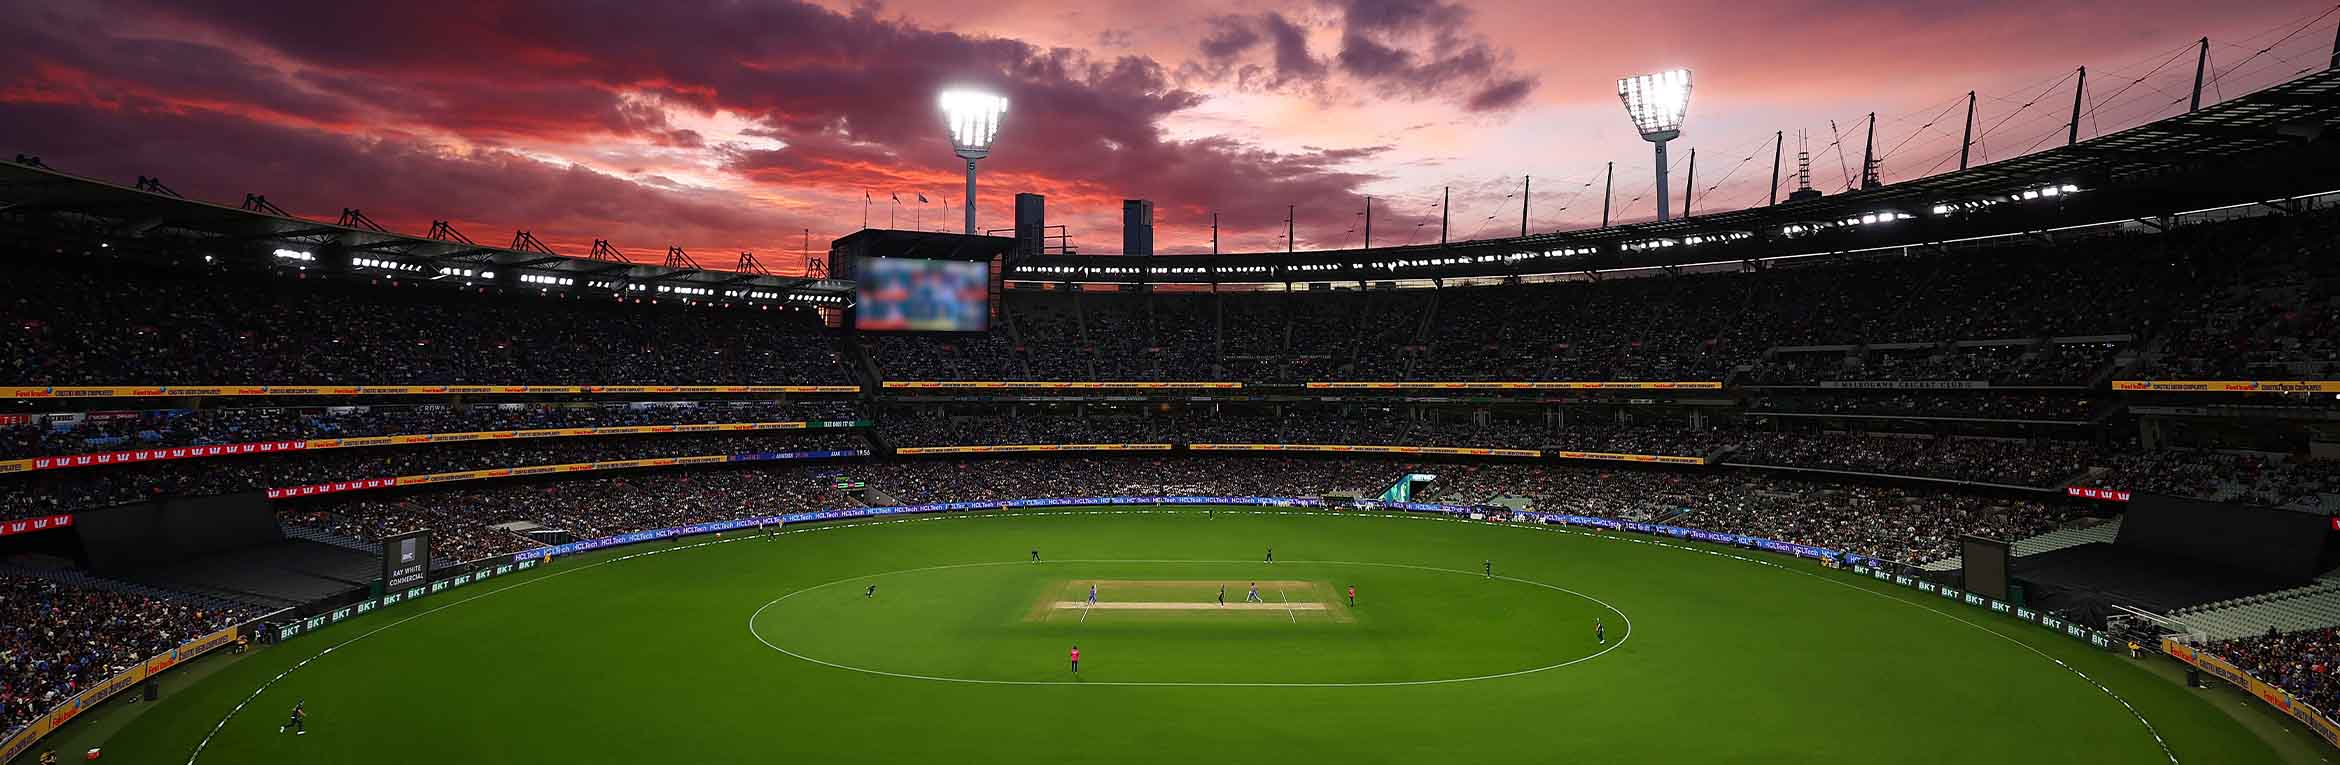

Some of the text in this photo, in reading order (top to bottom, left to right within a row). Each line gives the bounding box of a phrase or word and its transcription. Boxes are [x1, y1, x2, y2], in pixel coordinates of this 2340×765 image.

[573, 541, 598, 551] HCLTech
[602, 536, 626, 546] HCLTech
[629, 533, 654, 542] HCLTech
[683, 525, 707, 533] HCLTech
[709, 522, 734, 530] HCLTech
[736, 519, 760, 527] HCLTech
[790, 513, 813, 521] HCLTech
[816, 511, 839, 519] HCLTech
[841, 509, 864, 517] HCLTech
[895, 505, 918, 513] HCLTech
[920, 503, 943, 511] HCLTech
[389, 573, 424, 586] COMMERCIAL
[393, 564, 422, 577] RAY WHITE
[281, 560, 536, 640] BKT BKT BKT BKT BKT BKT BKT BKT BKT BKT BKT
[1854, 565, 2110, 648] BKT BKT BKT BKT BKT BKT BKT BKT BKT BKT BKT
